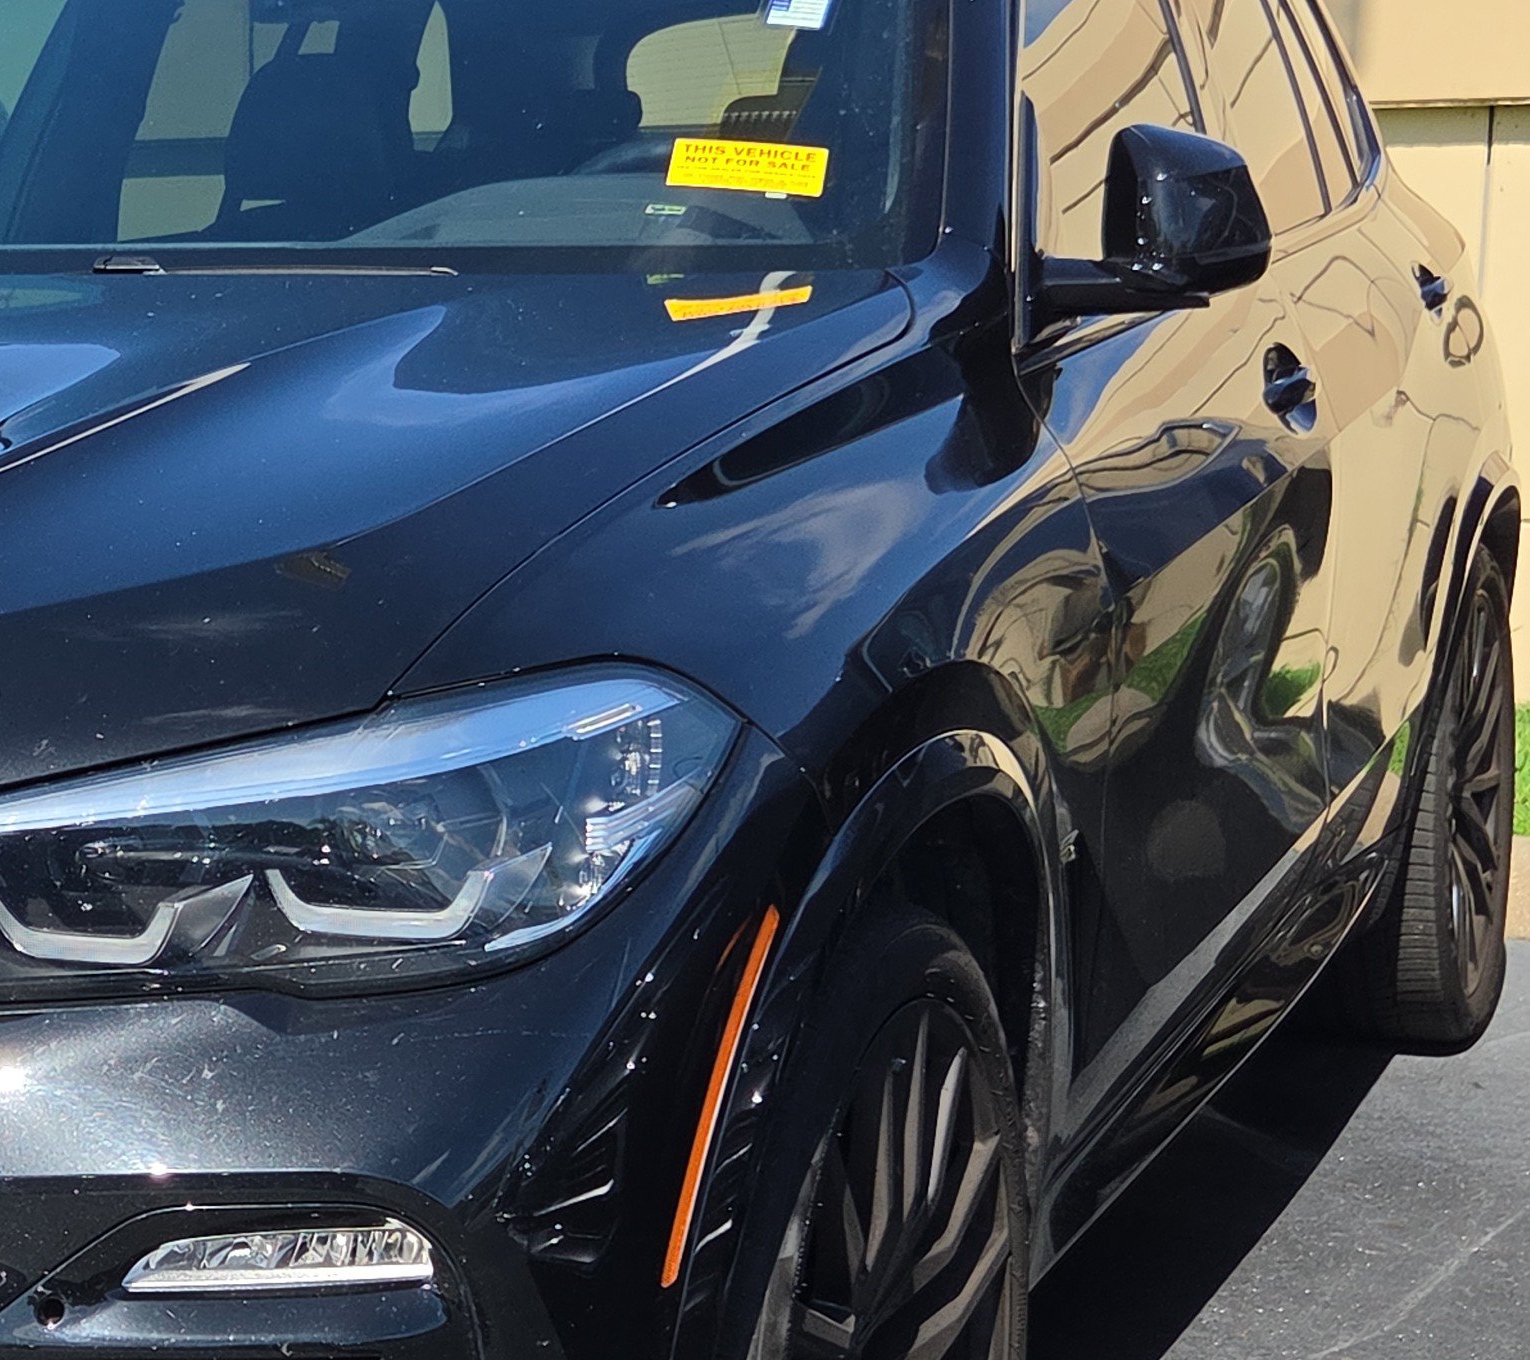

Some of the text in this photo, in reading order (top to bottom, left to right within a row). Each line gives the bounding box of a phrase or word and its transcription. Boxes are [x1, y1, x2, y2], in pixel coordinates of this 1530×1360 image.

[683, 143, 817, 163] THIS VEHICLE
[684, 155, 718, 165] NOT
[725, 158, 760, 168] FOR
[767, 160, 811, 172] SALE
